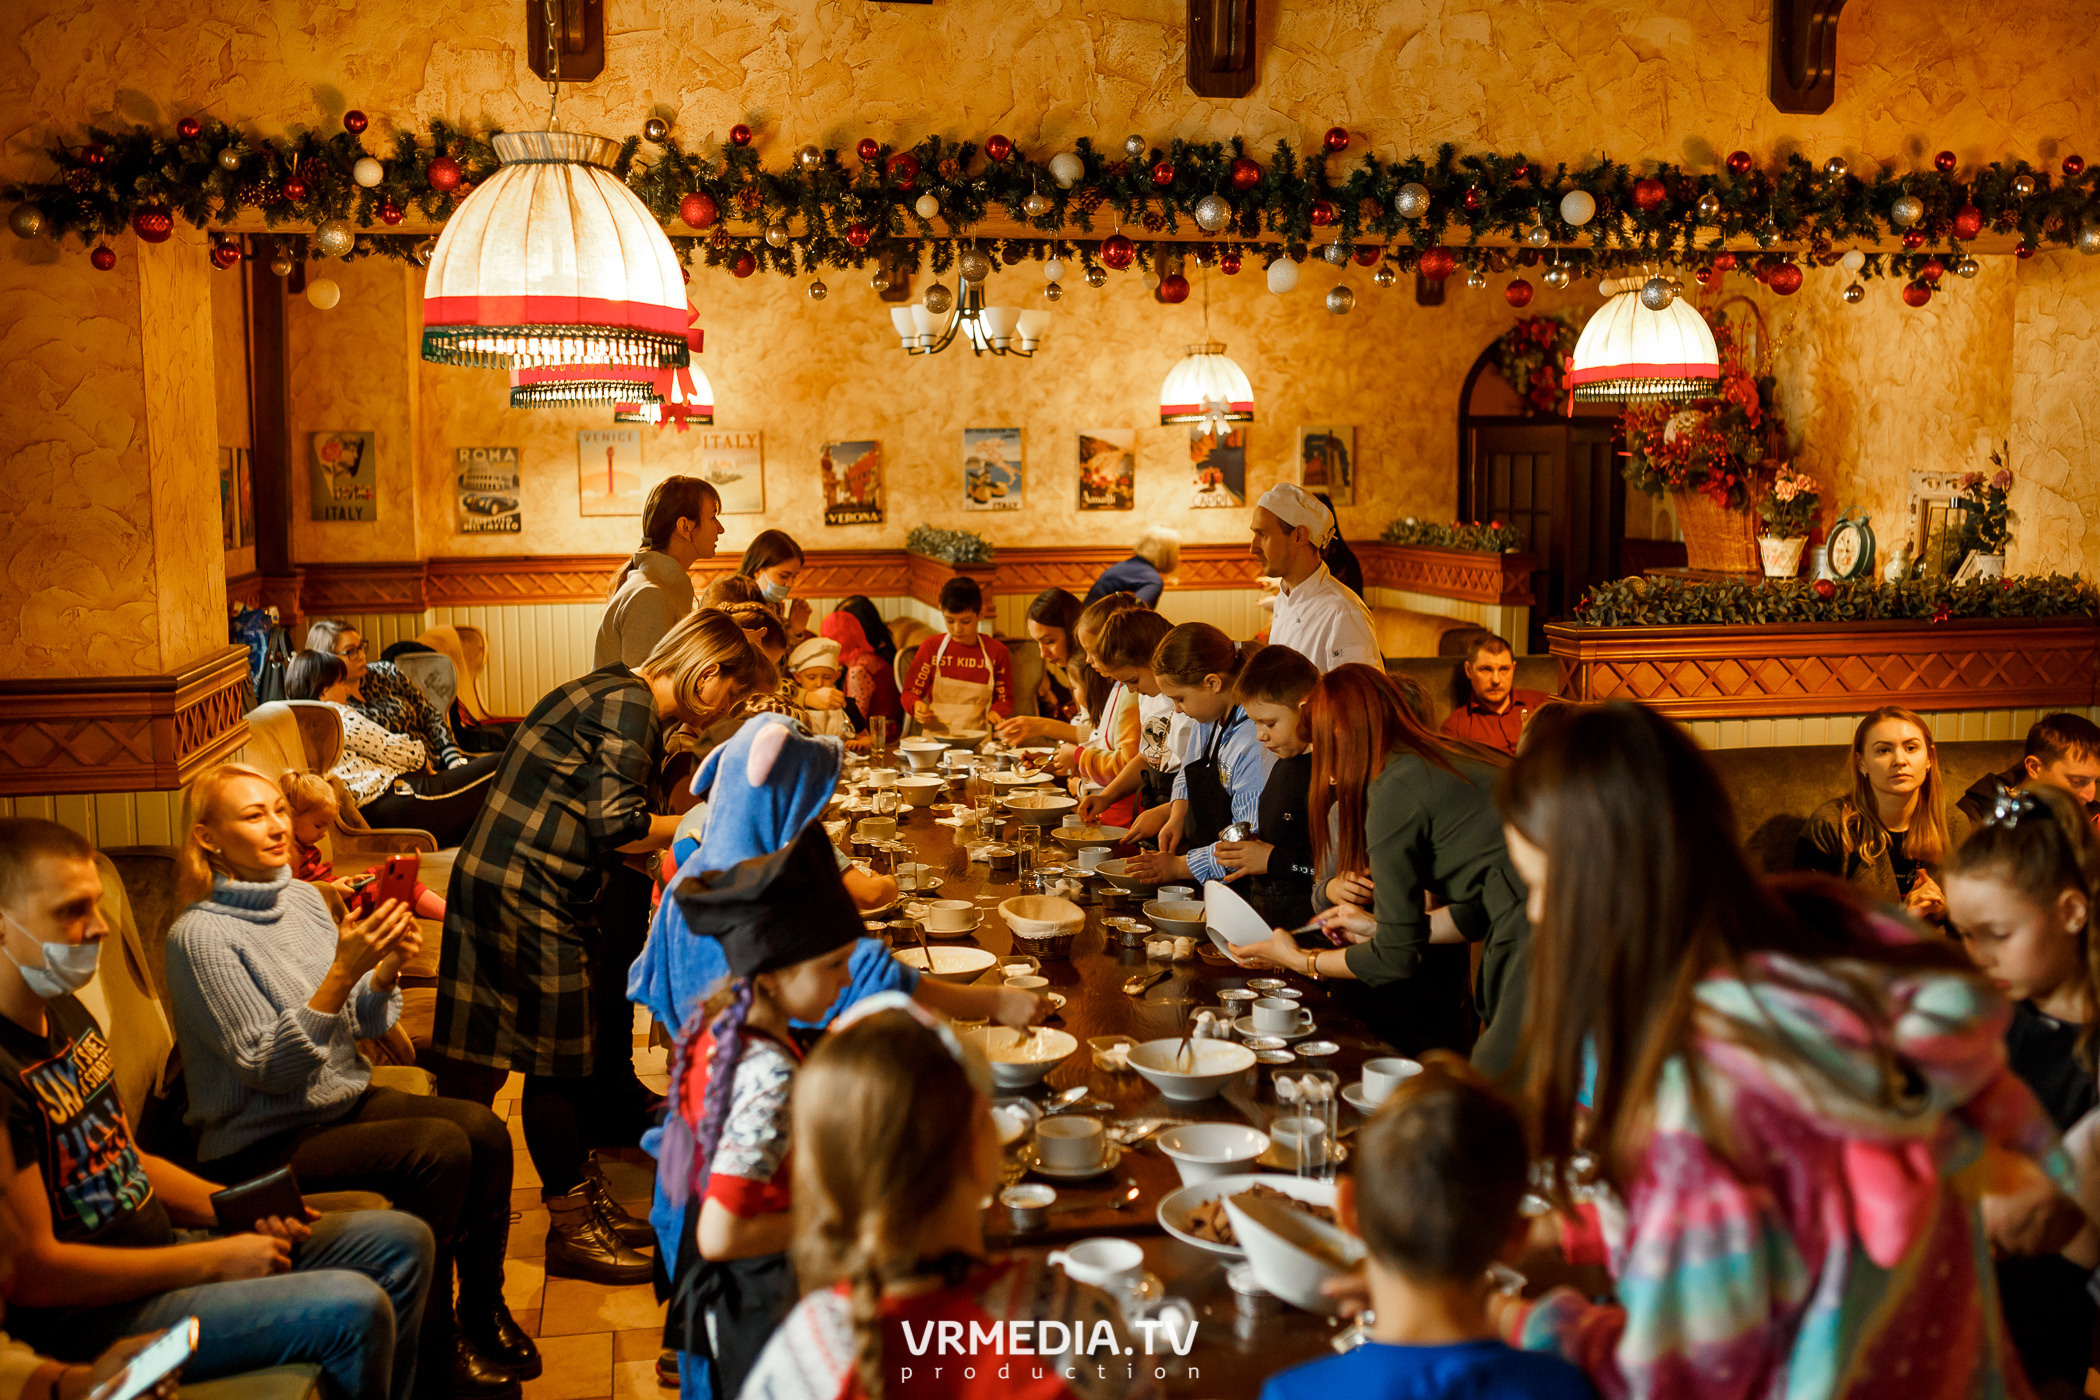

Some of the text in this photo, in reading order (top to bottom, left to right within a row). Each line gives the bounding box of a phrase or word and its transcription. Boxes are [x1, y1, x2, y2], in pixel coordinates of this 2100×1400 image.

[583, 432, 633, 443] VENICE
[704, 434, 758, 449] ITALY
[460, 449, 516, 462] ROMA
[325, 506, 363, 520] ITALY
[828, 512, 878, 524] VERONA
[32, 1060, 85, 1125] SAY
